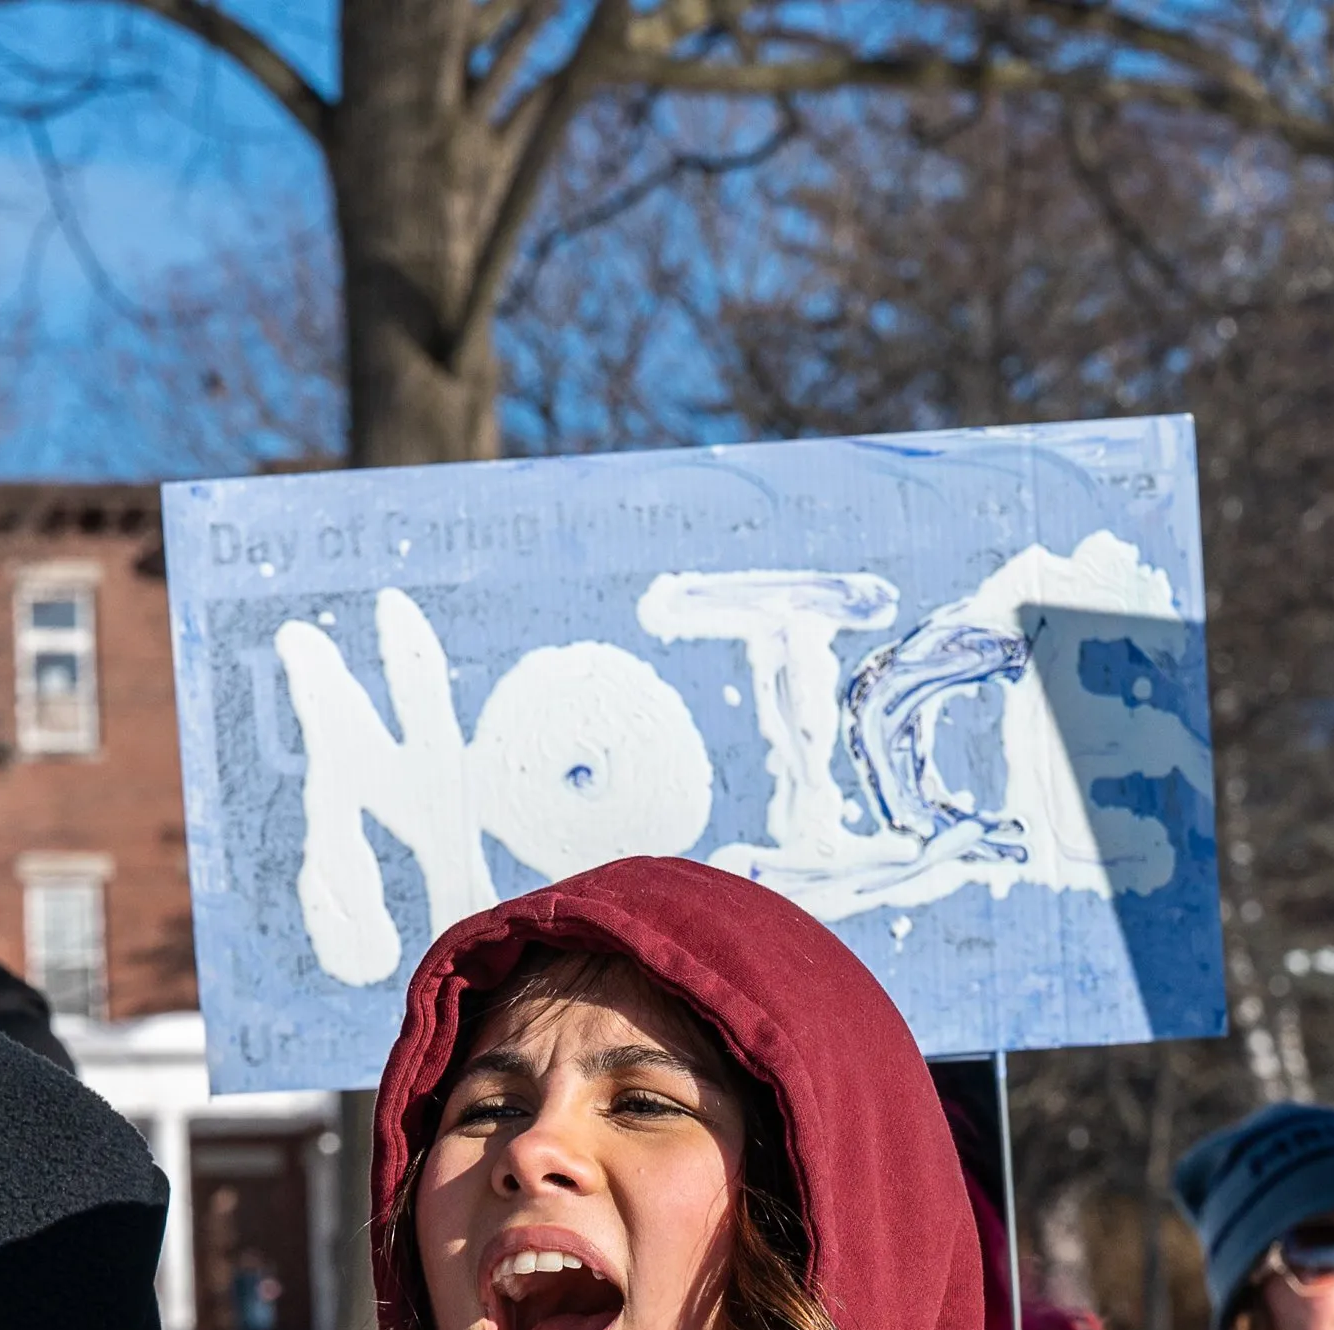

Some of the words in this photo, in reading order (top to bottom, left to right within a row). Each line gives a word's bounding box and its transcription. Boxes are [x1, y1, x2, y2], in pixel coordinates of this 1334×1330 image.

[208, 520, 297, 572] Day
[318, 511, 365, 560] of
[274, 586, 713, 985] NO
